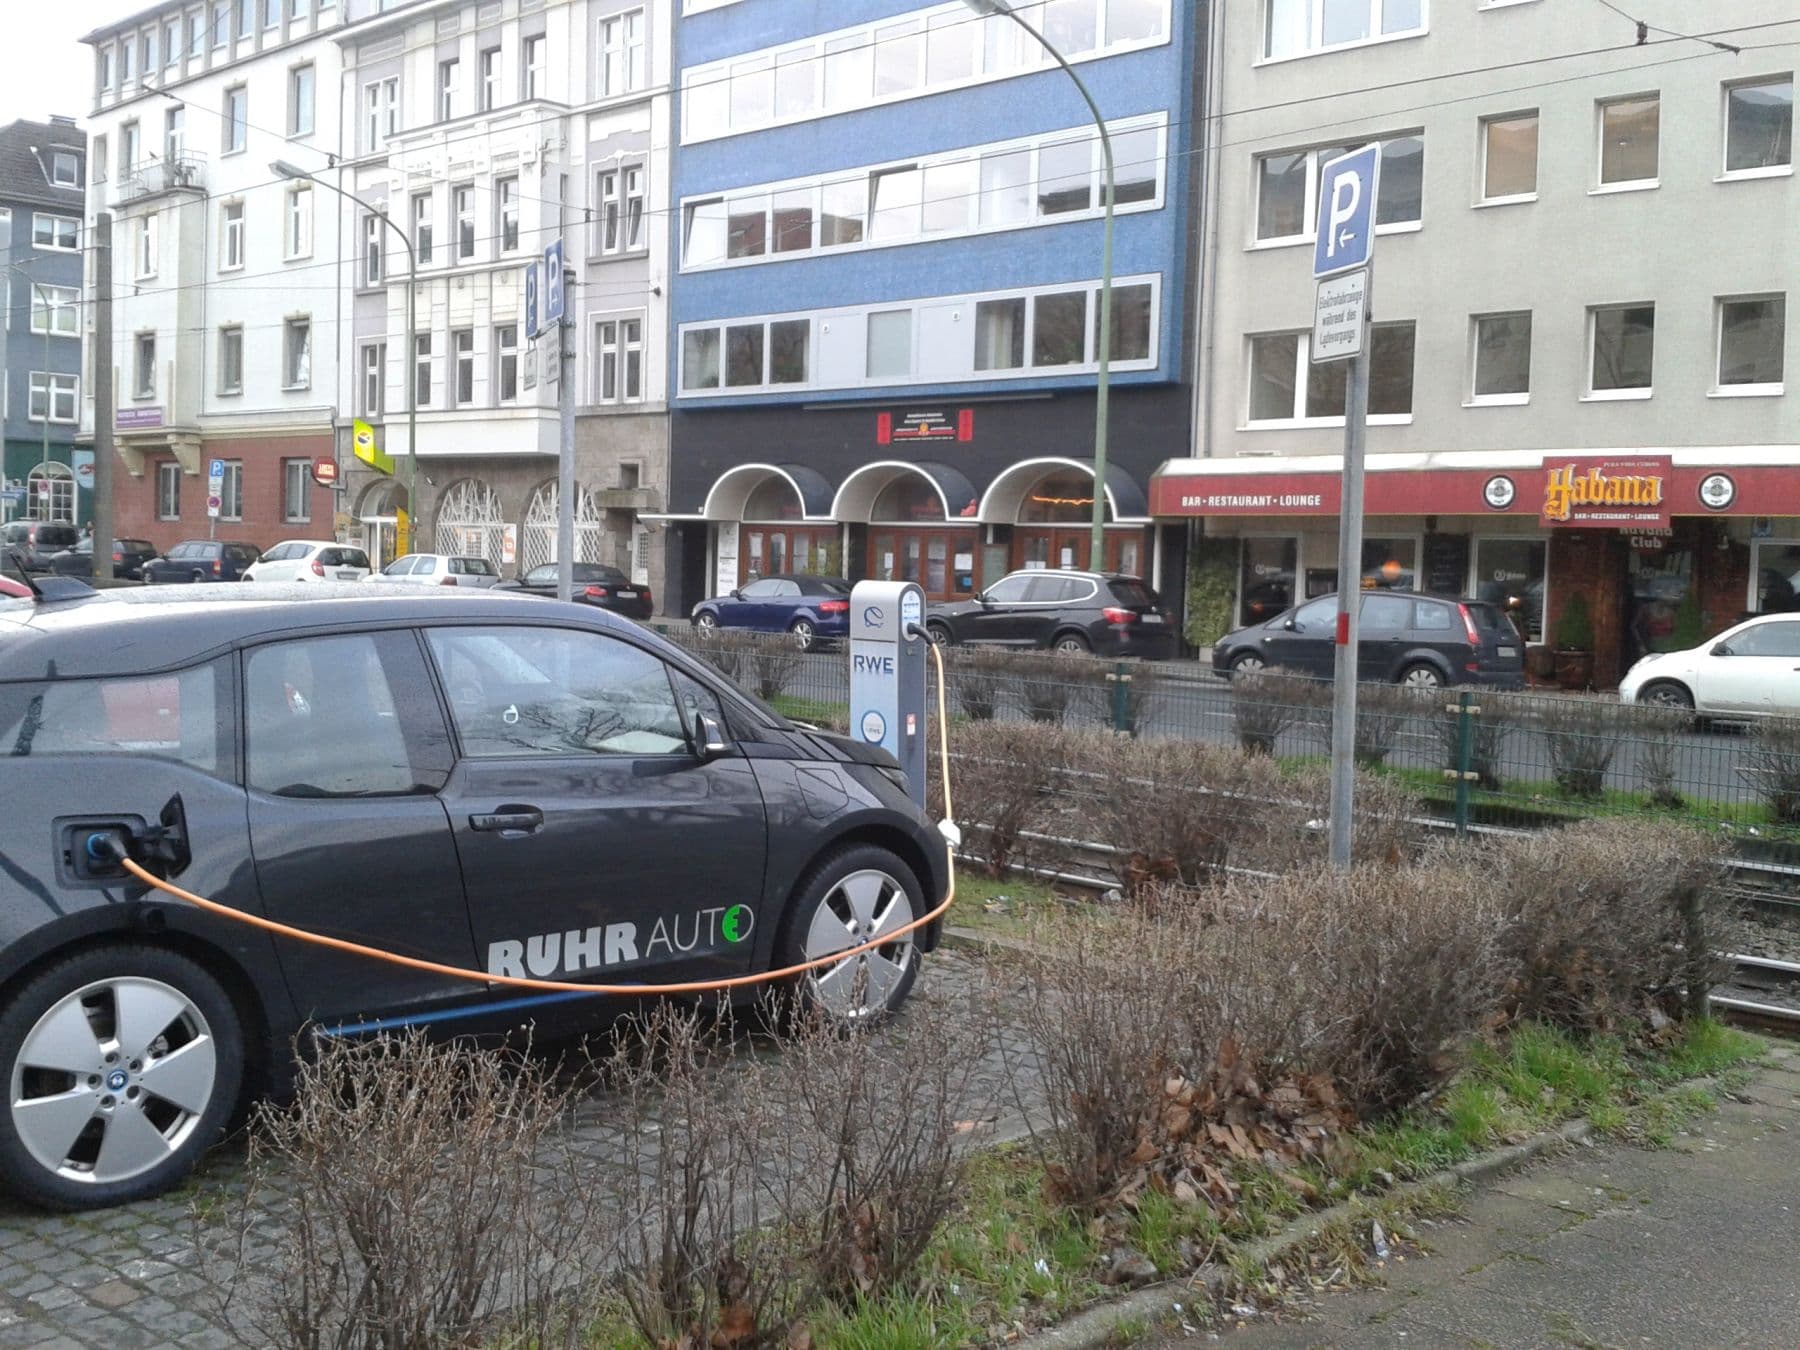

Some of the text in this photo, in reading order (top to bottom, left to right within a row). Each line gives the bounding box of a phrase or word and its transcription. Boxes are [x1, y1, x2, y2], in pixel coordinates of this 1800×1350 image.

[1327, 170, 1360, 258] P
[1182, 494, 1321, 507] BAR RESTAURANT LOUNGE
[1543, 464, 1663, 520] Habana
[1631, 536, 1662, 548] Club
[853, 654, 894, 674] RWE
[488, 921, 639, 985] RUHR
